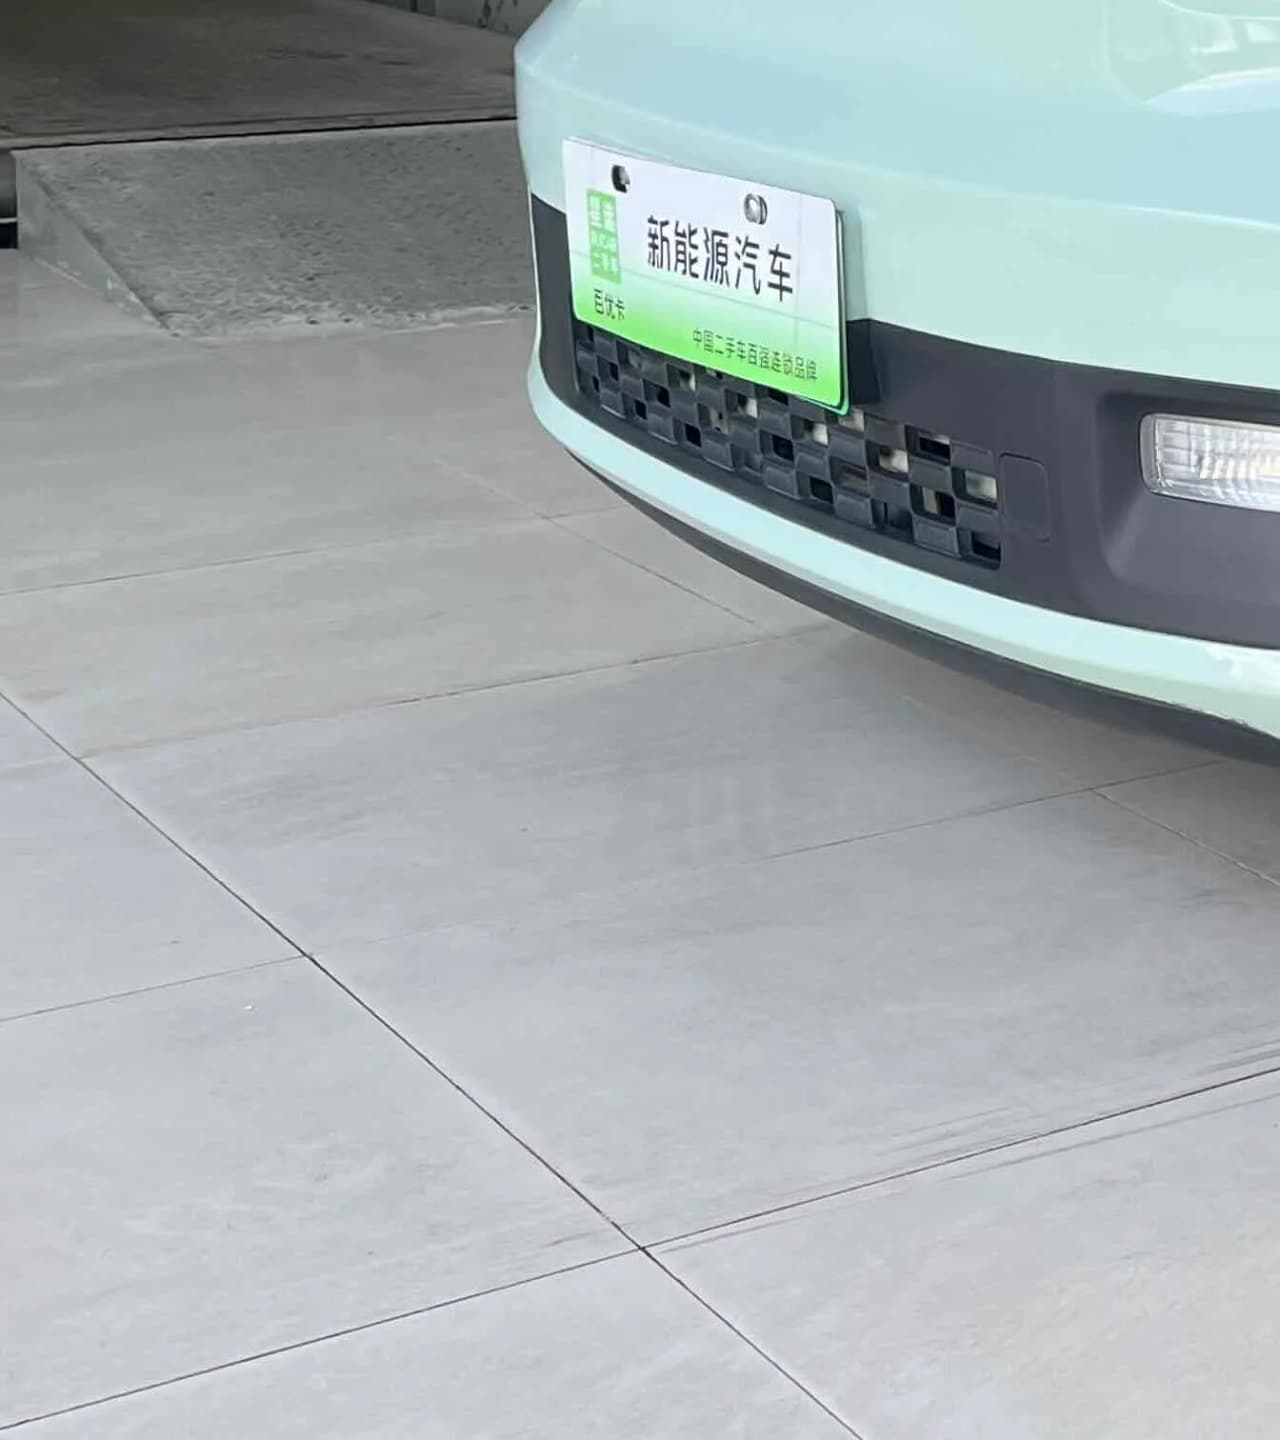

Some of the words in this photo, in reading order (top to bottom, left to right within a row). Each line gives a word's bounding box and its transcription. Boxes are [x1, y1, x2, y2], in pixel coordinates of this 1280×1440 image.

[647, 215, 794, 303] 新能源汽车
